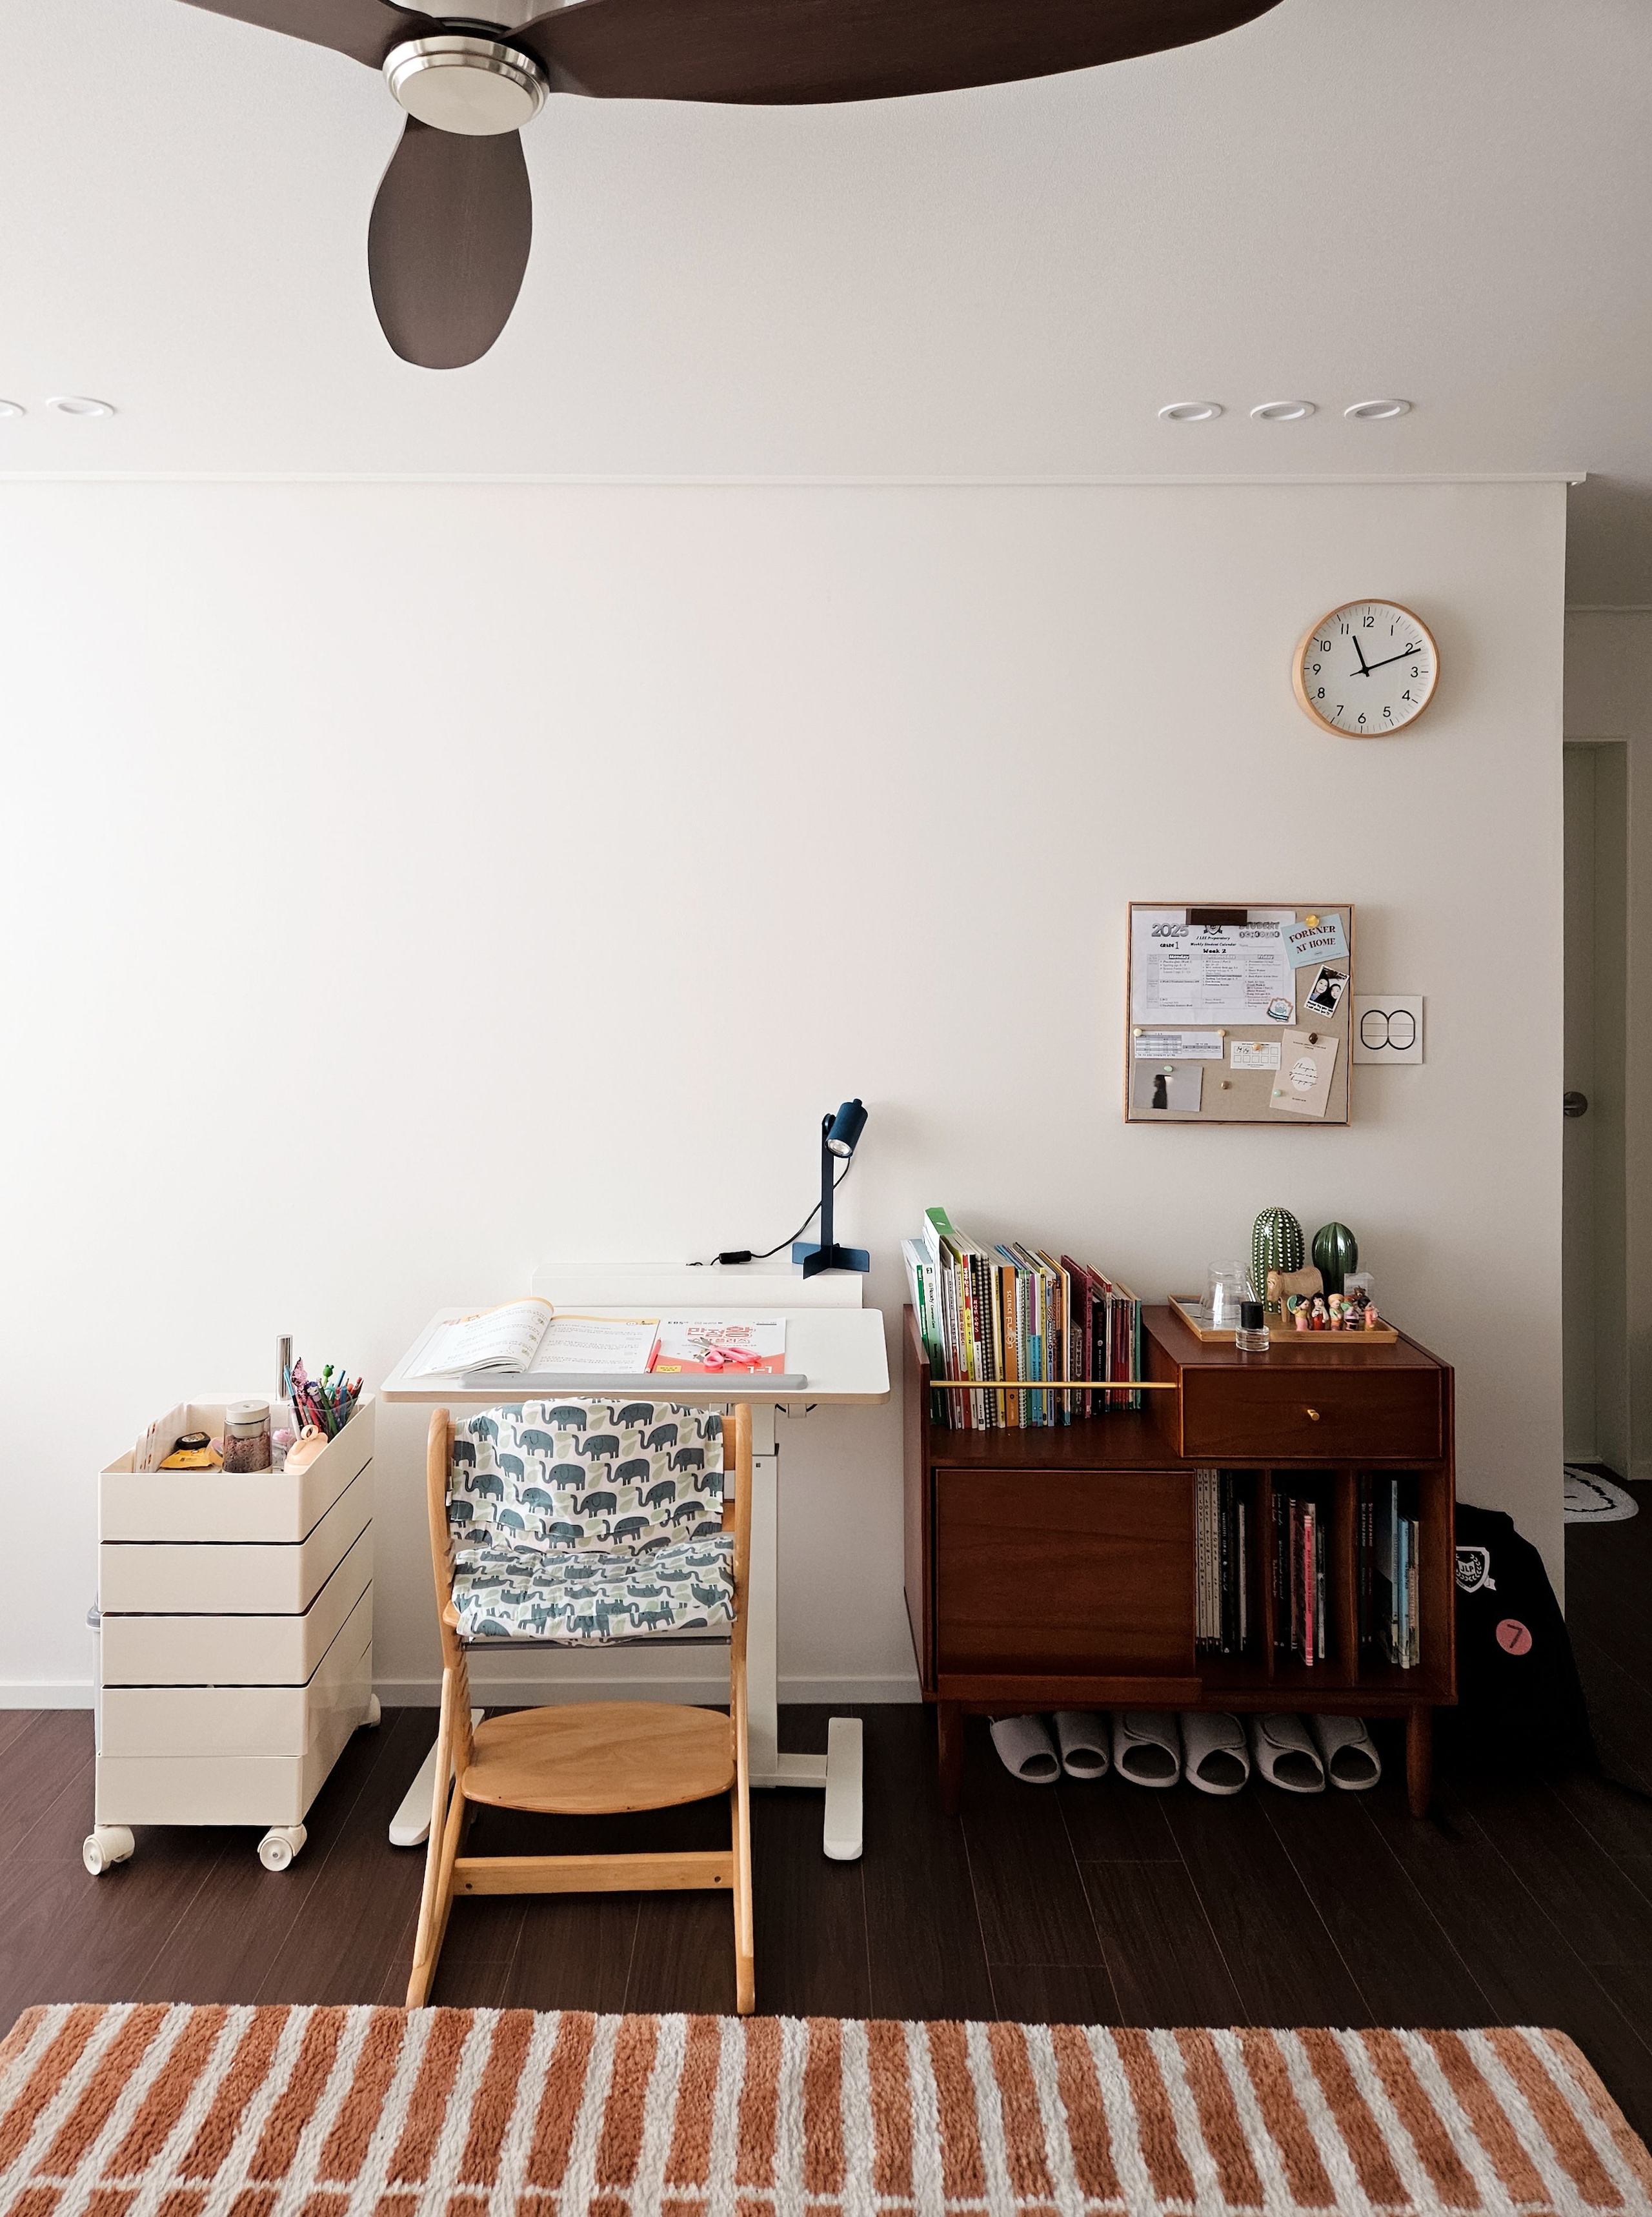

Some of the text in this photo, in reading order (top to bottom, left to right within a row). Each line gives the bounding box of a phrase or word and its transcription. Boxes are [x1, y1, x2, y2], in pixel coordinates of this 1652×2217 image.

[1363, 616, 1375, 628] 12
[1341, 623, 1349, 634] 11
[1390, 625, 1394, 636] 1
[1320, 640, 1331, 652] 10
[1405, 643, 1414, 654] 2
[1313, 663, 1321, 675] 9
[1411, 666, 1418, 678] 3
[1317, 687, 1325, 699] 8
[1402, 689, 1411, 701] 4
[1336, 705, 1344, 716] 7
[1383, 706, 1391, 718] 5
[1358, 713, 1366, 724] 6
[1151, 923, 1189, 937] 2025
[1289, 926, 1336, 943] FORKNER
[1296, 938, 1336, 954] AT HOME
[687, 1326, 754, 1338] 만점왕
[747, 1366, 772, 1374] 1-1
[1460, 1564, 1475, 1573] JLP
[1507, 1623, 1523, 1649] 7
